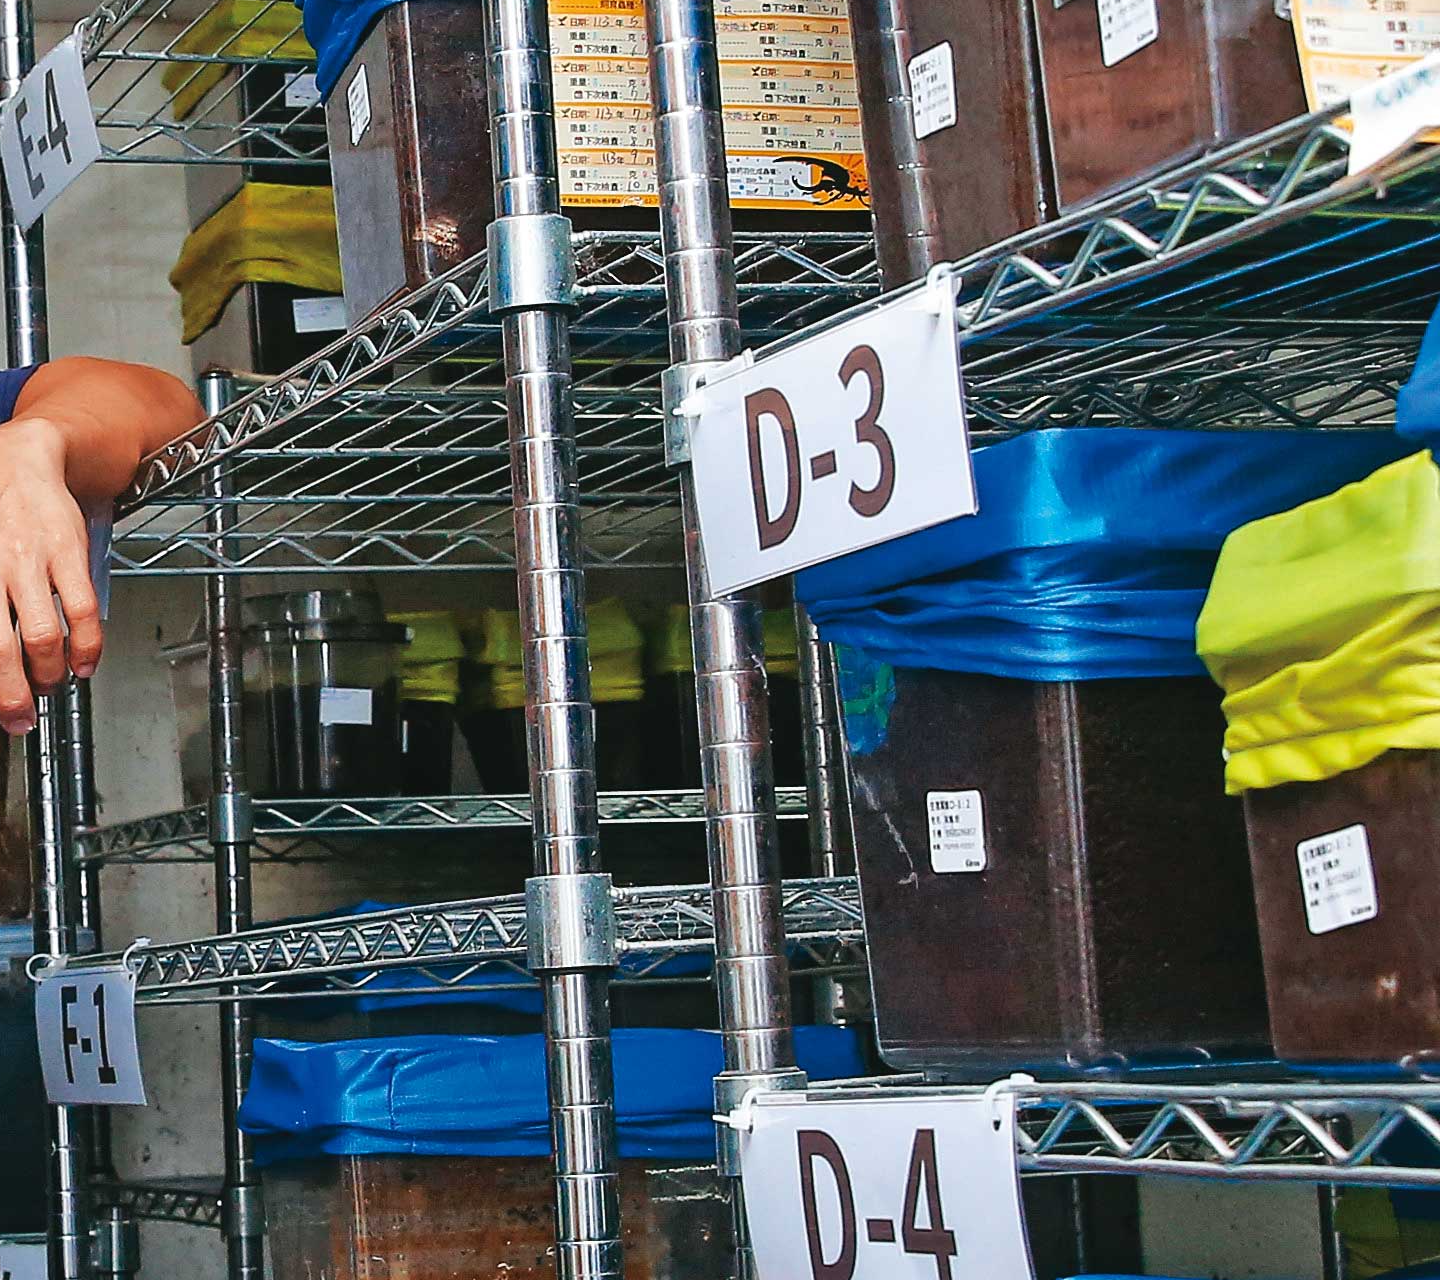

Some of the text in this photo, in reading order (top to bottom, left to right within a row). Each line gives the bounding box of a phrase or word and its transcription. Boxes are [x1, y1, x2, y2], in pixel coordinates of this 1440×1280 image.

[15, 70, 72, 200] E-4
[742, 342, 897, 553] D-3
[62, 982, 118, 1085] F-1
